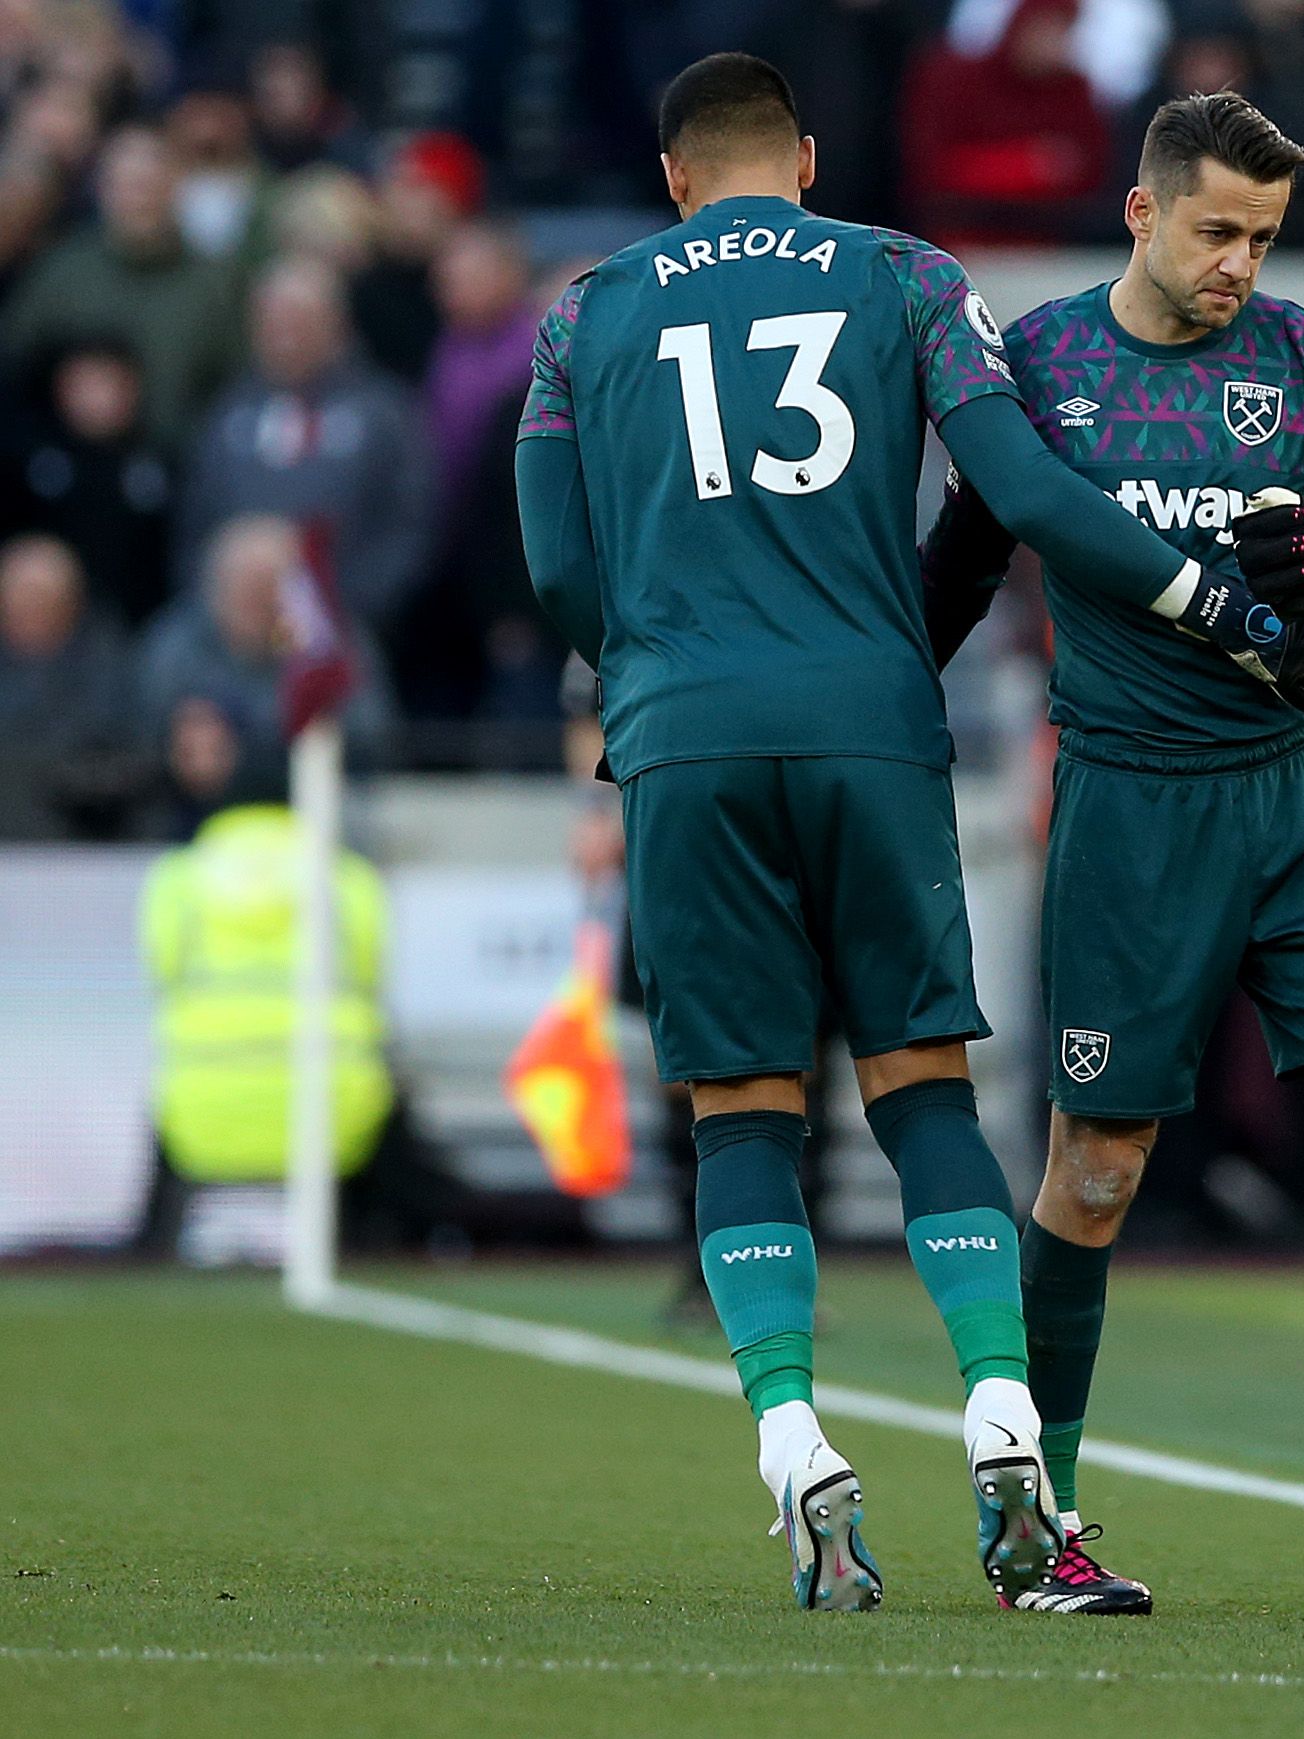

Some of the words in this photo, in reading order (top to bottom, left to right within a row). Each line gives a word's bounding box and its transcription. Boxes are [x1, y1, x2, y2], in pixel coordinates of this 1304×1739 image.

[653, 227, 838, 287] AREOLA
[1255, 388, 1277, 398] HAM
[657, 311, 855, 500] 13
[1060, 416, 1095, 427] umbro
[1103, 480, 1256, 545] tway
[925, 1236, 998, 1252] WHU
[721, 1245, 792, 1264] WHU
